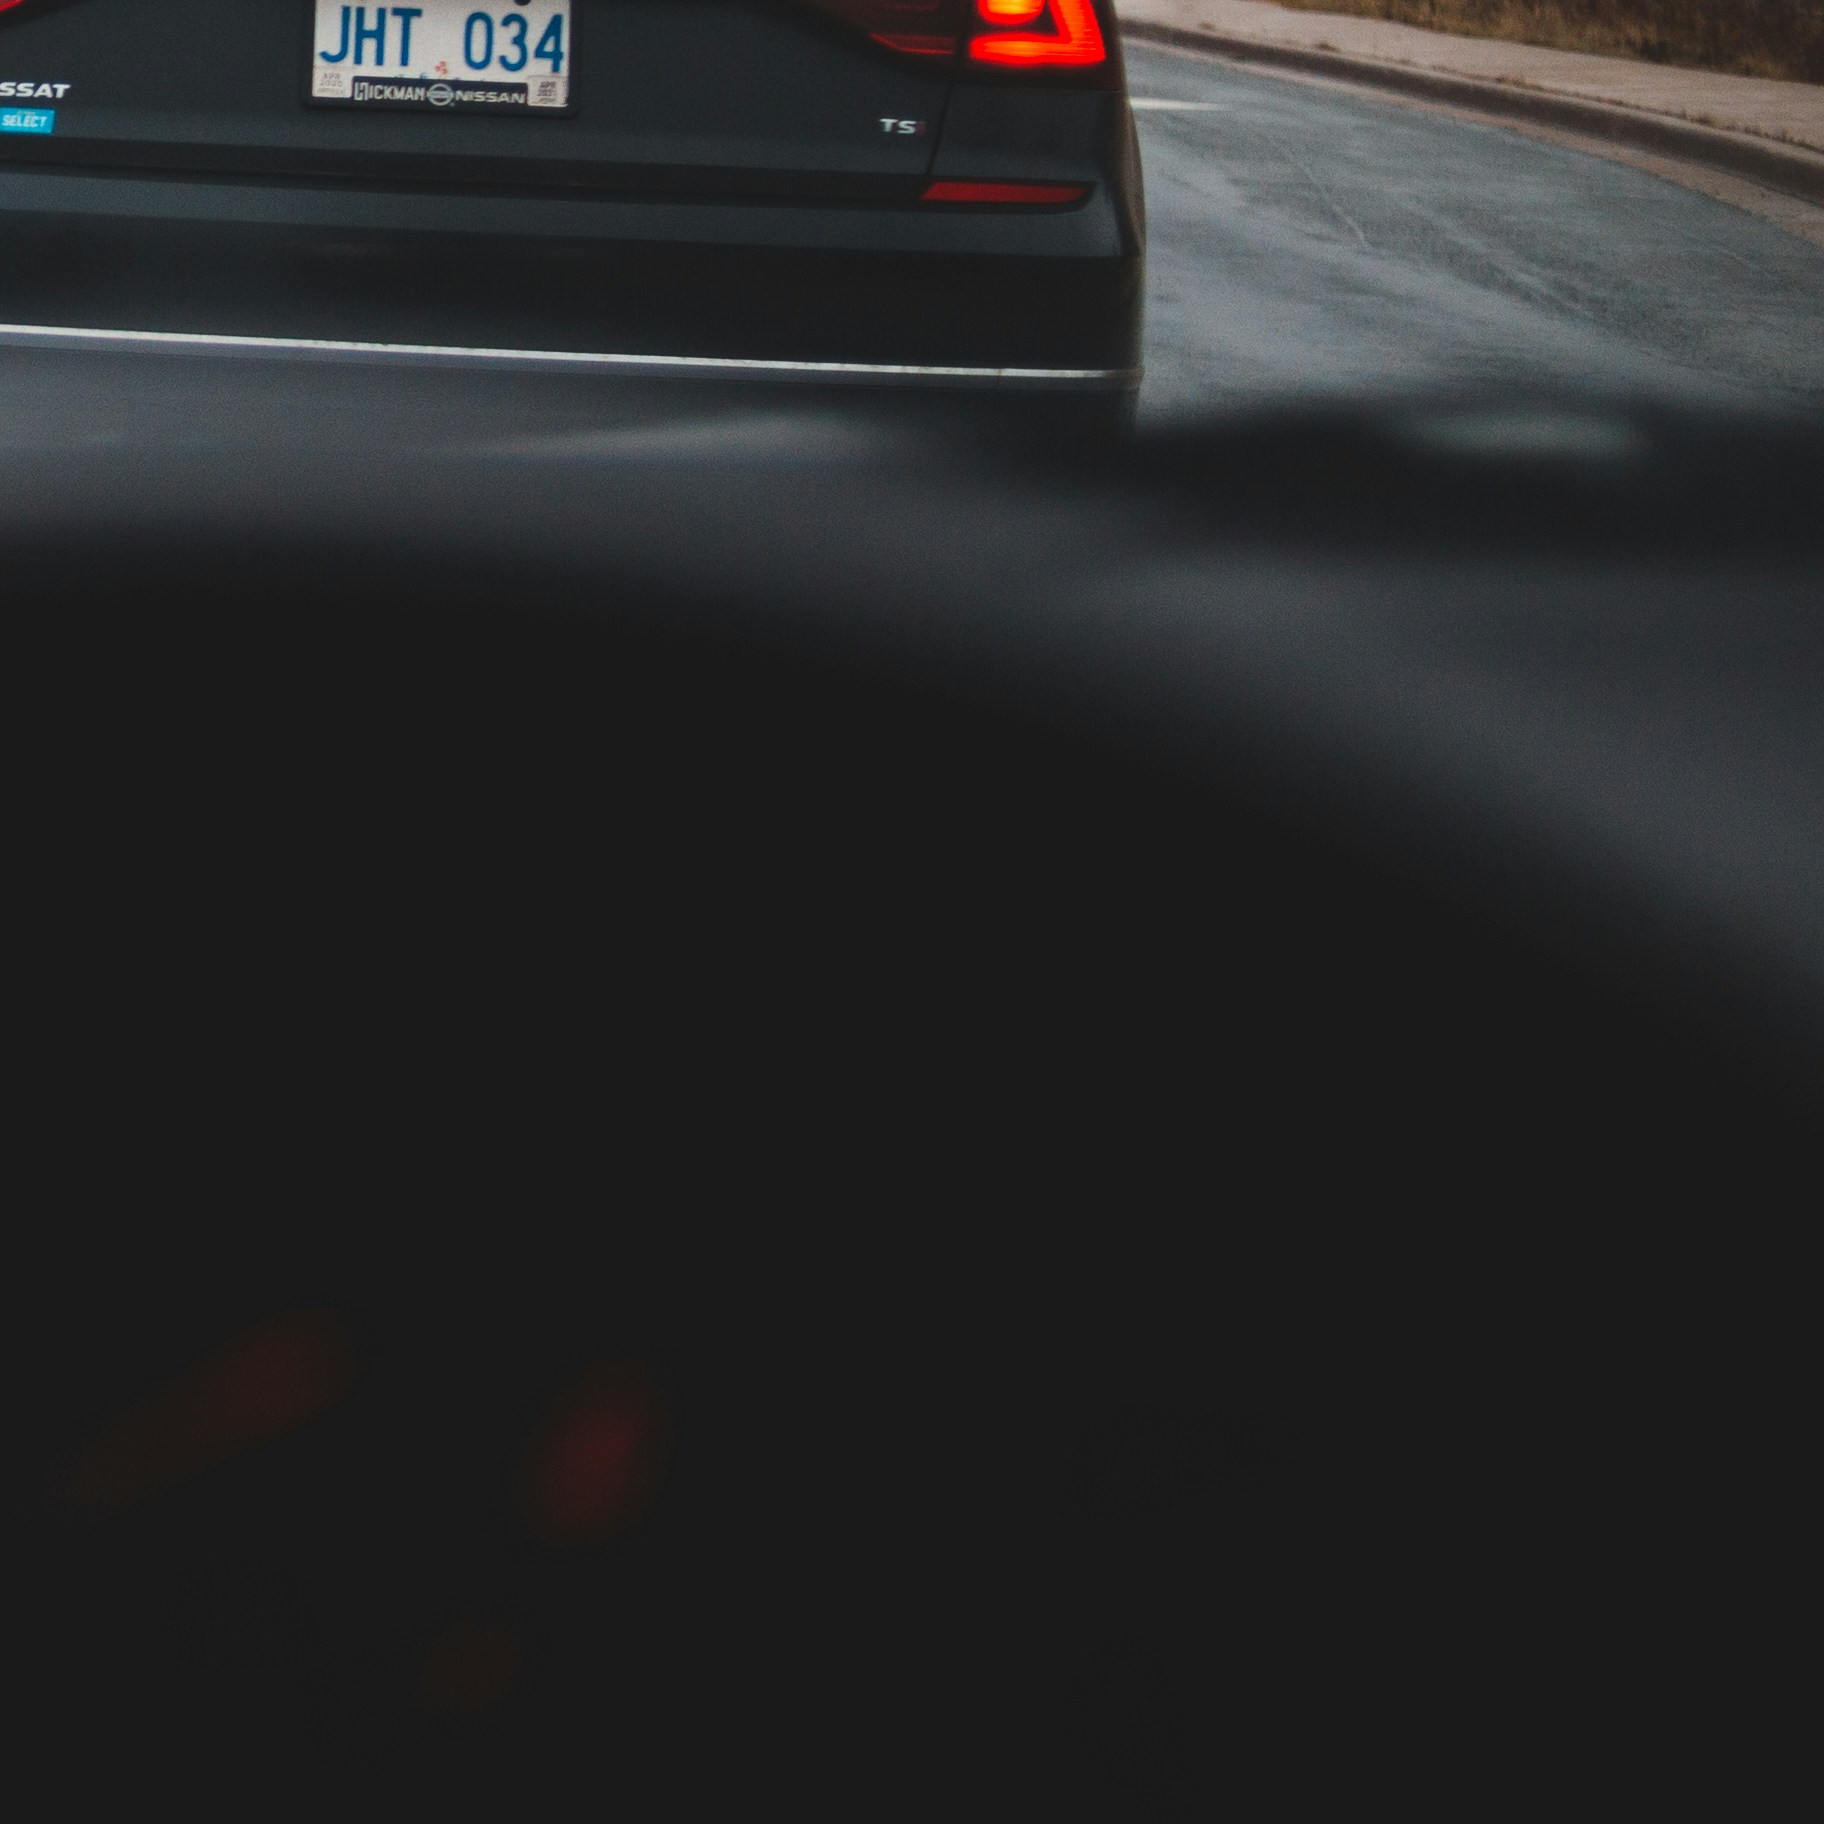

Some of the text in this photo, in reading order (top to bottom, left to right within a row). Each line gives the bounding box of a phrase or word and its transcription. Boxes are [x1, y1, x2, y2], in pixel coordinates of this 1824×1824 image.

[319, 5, 564, 73] JHT 034
[354, 82, 425, 102] HICKMAN
[455, 90, 525, 104] NISSAN
[2, 113, 47, 128] SELECT
